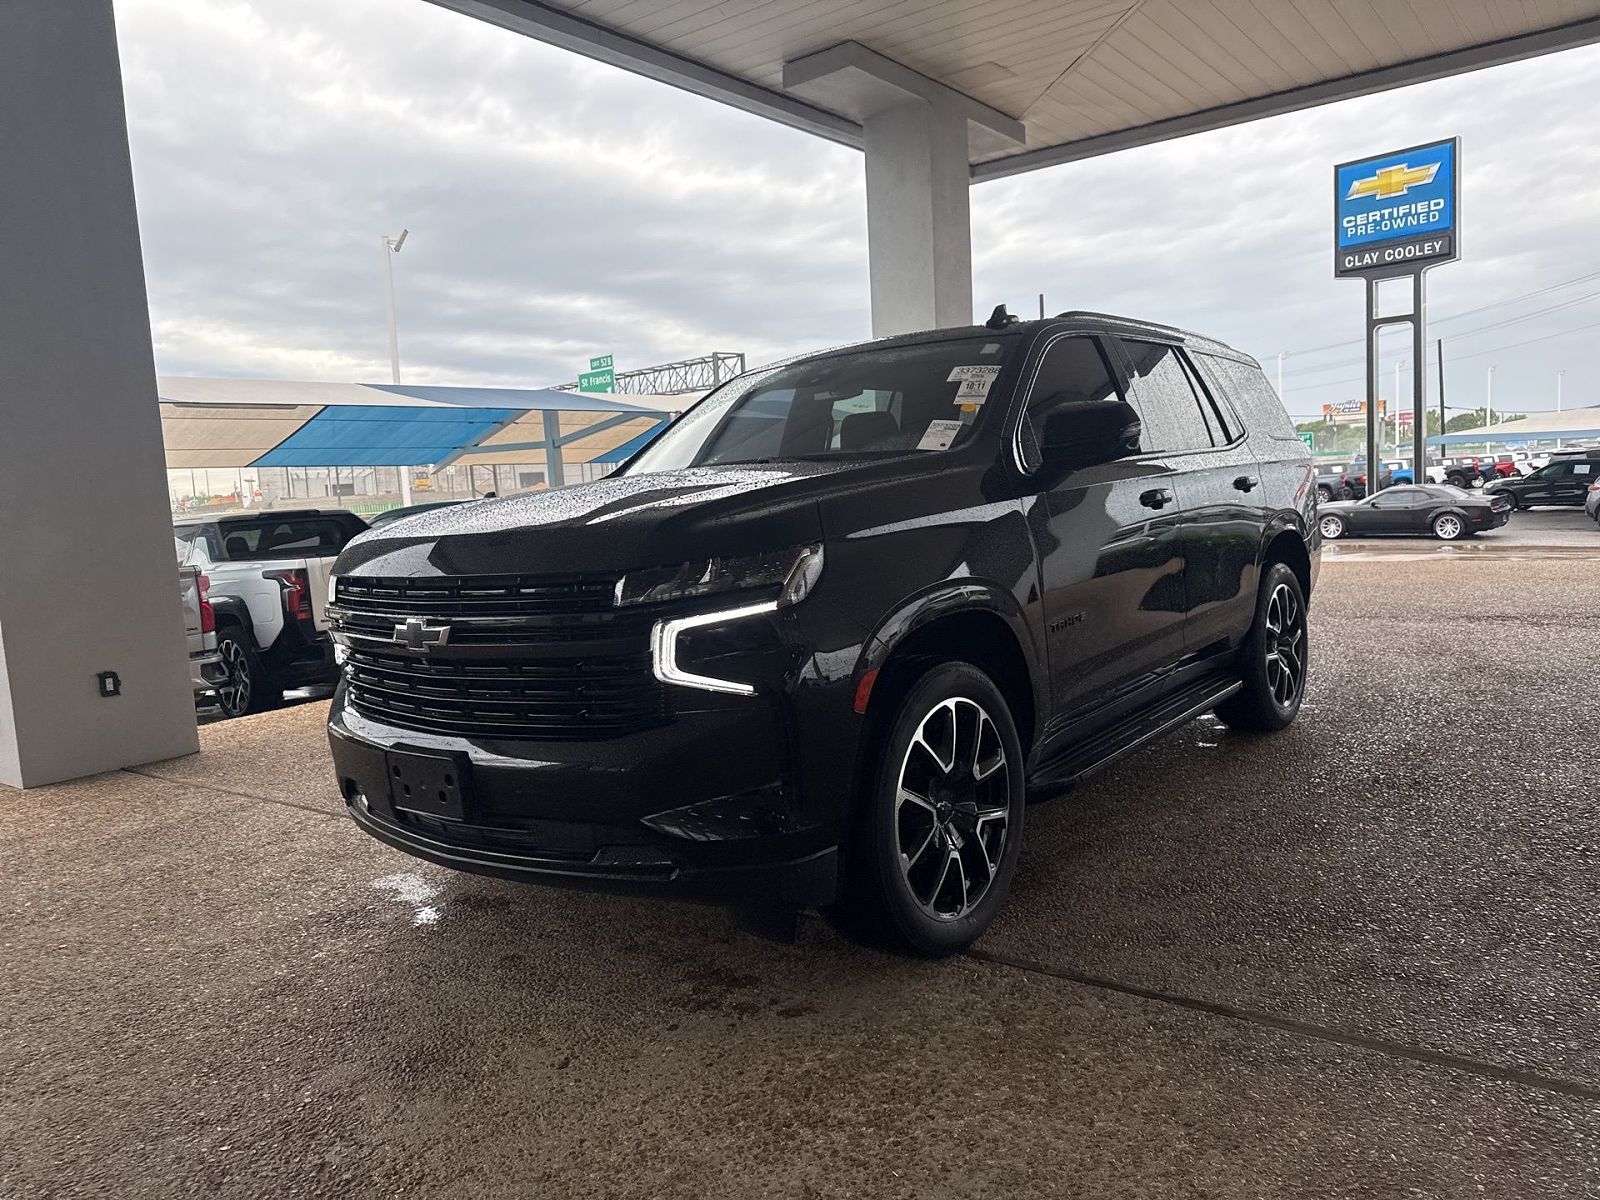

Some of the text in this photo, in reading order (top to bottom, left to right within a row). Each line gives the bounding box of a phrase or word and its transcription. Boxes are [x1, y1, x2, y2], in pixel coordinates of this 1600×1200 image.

[1343, 199, 1444, 228] CERTIFIED
[1347, 211, 1439, 237] PRE-OWNED
[1345, 241, 1442, 268] CLAY COOLEY
[590, 374, 611, 386] Francis
